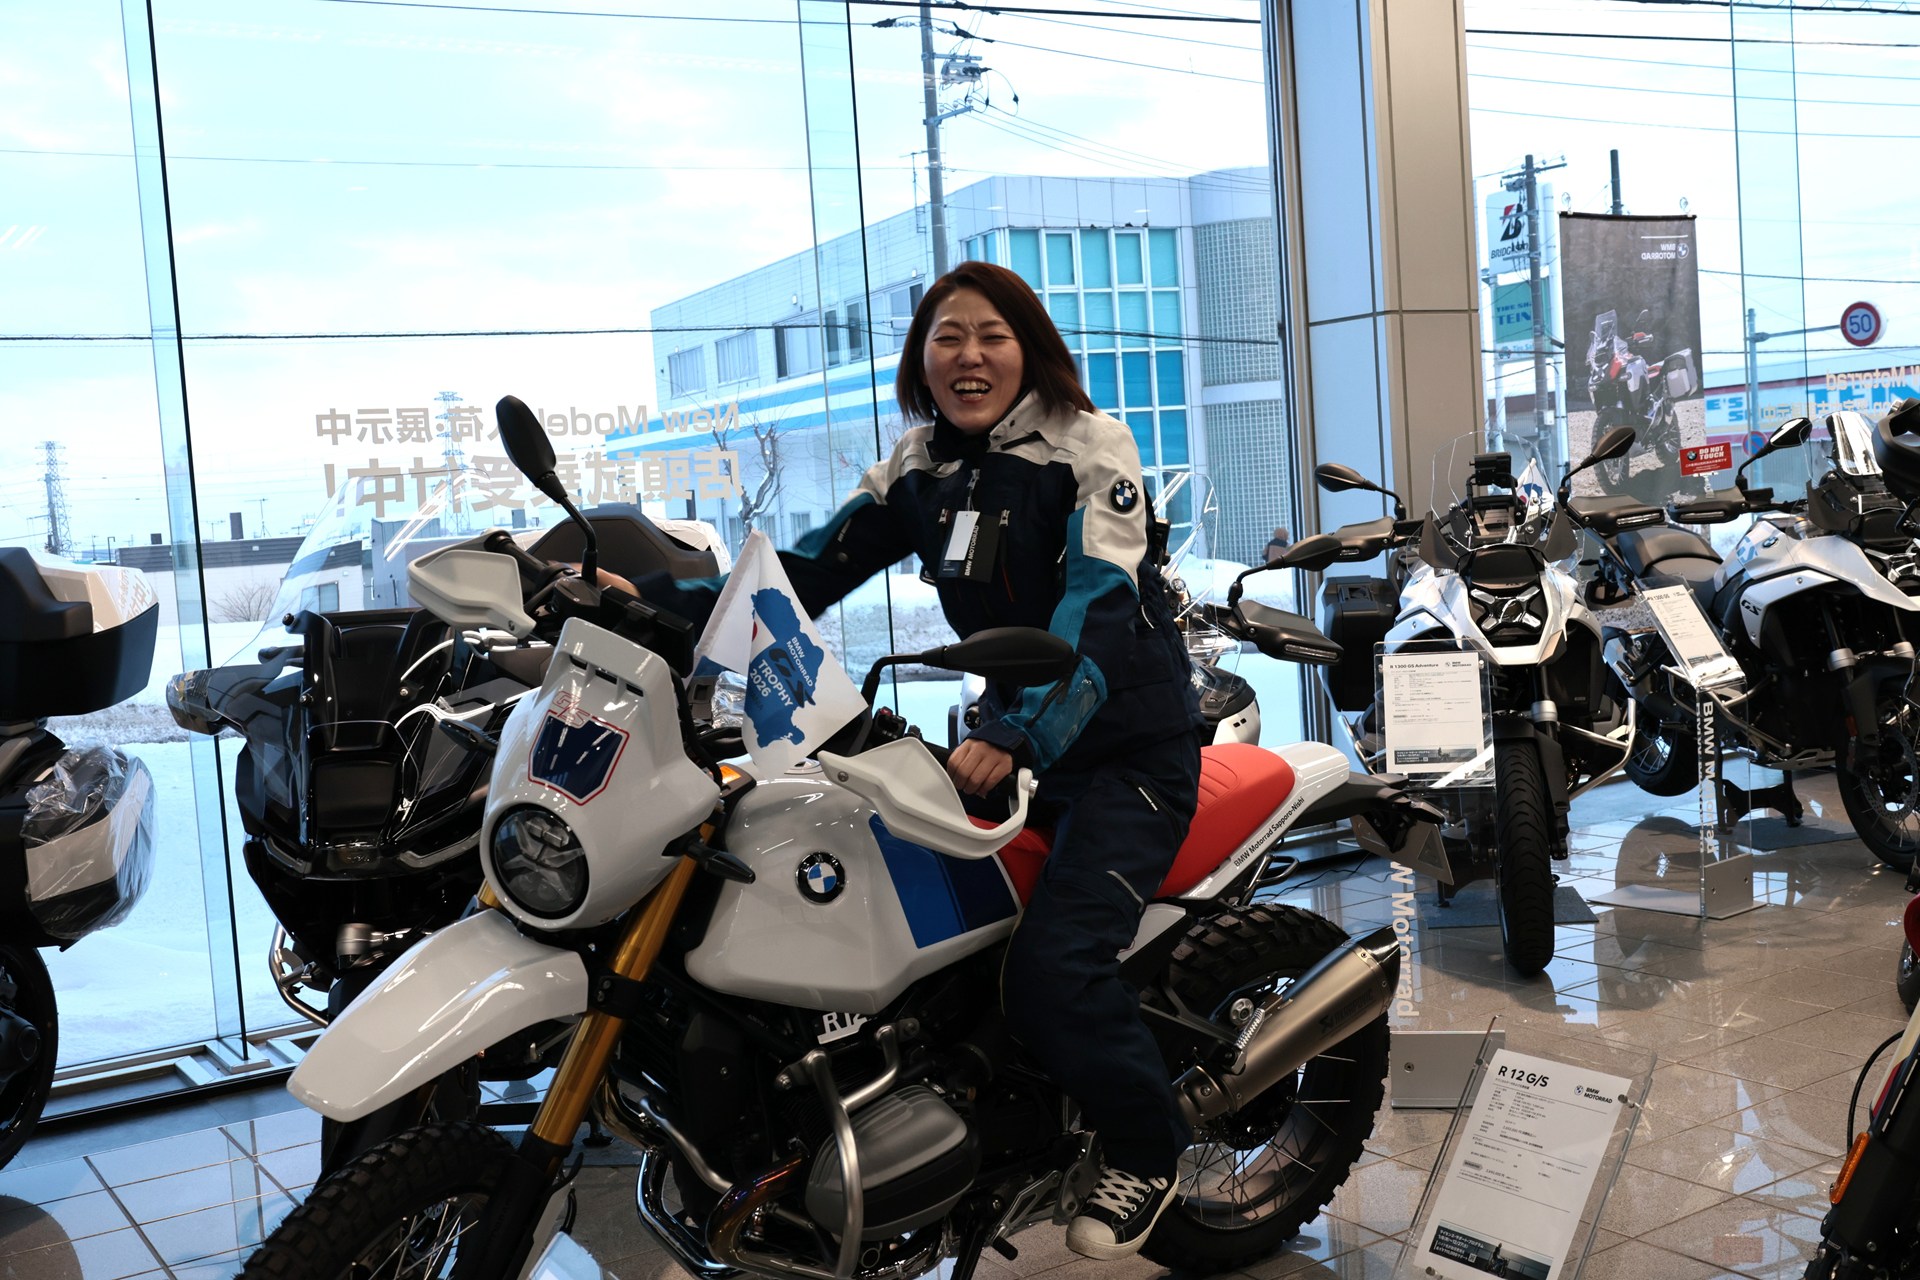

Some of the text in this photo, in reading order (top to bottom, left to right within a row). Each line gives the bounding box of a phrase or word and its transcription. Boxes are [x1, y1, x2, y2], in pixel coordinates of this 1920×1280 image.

[1849, 313, 1873, 334] 50
[1699, 451, 1725, 460] TOUCH
[1710, 445, 1725, 453] NOT
[1115, 481, 1137, 494] BMW
[964, 559, 973, 576] BMW
[790, 636, 806, 659] BMW
[786, 640, 813, 688] MOTORRAD
[749, 668, 772, 698] 2026
[757, 658, 794, 707] TROPHY
[1703, 701, 1719, 854] BMW Motorrad
[1233, 797, 1305, 867] BMW Motorrad Sapporo-Nishi
[1498, 1065, 1508, 1077] R
[1510, 1068, 1525, 1081] 12
[1526, 1072, 1549, 1088] G/S
[1583, 1092, 1613, 1104] MOTORRAD
[1585, 1087, 1600, 1095] BMW
